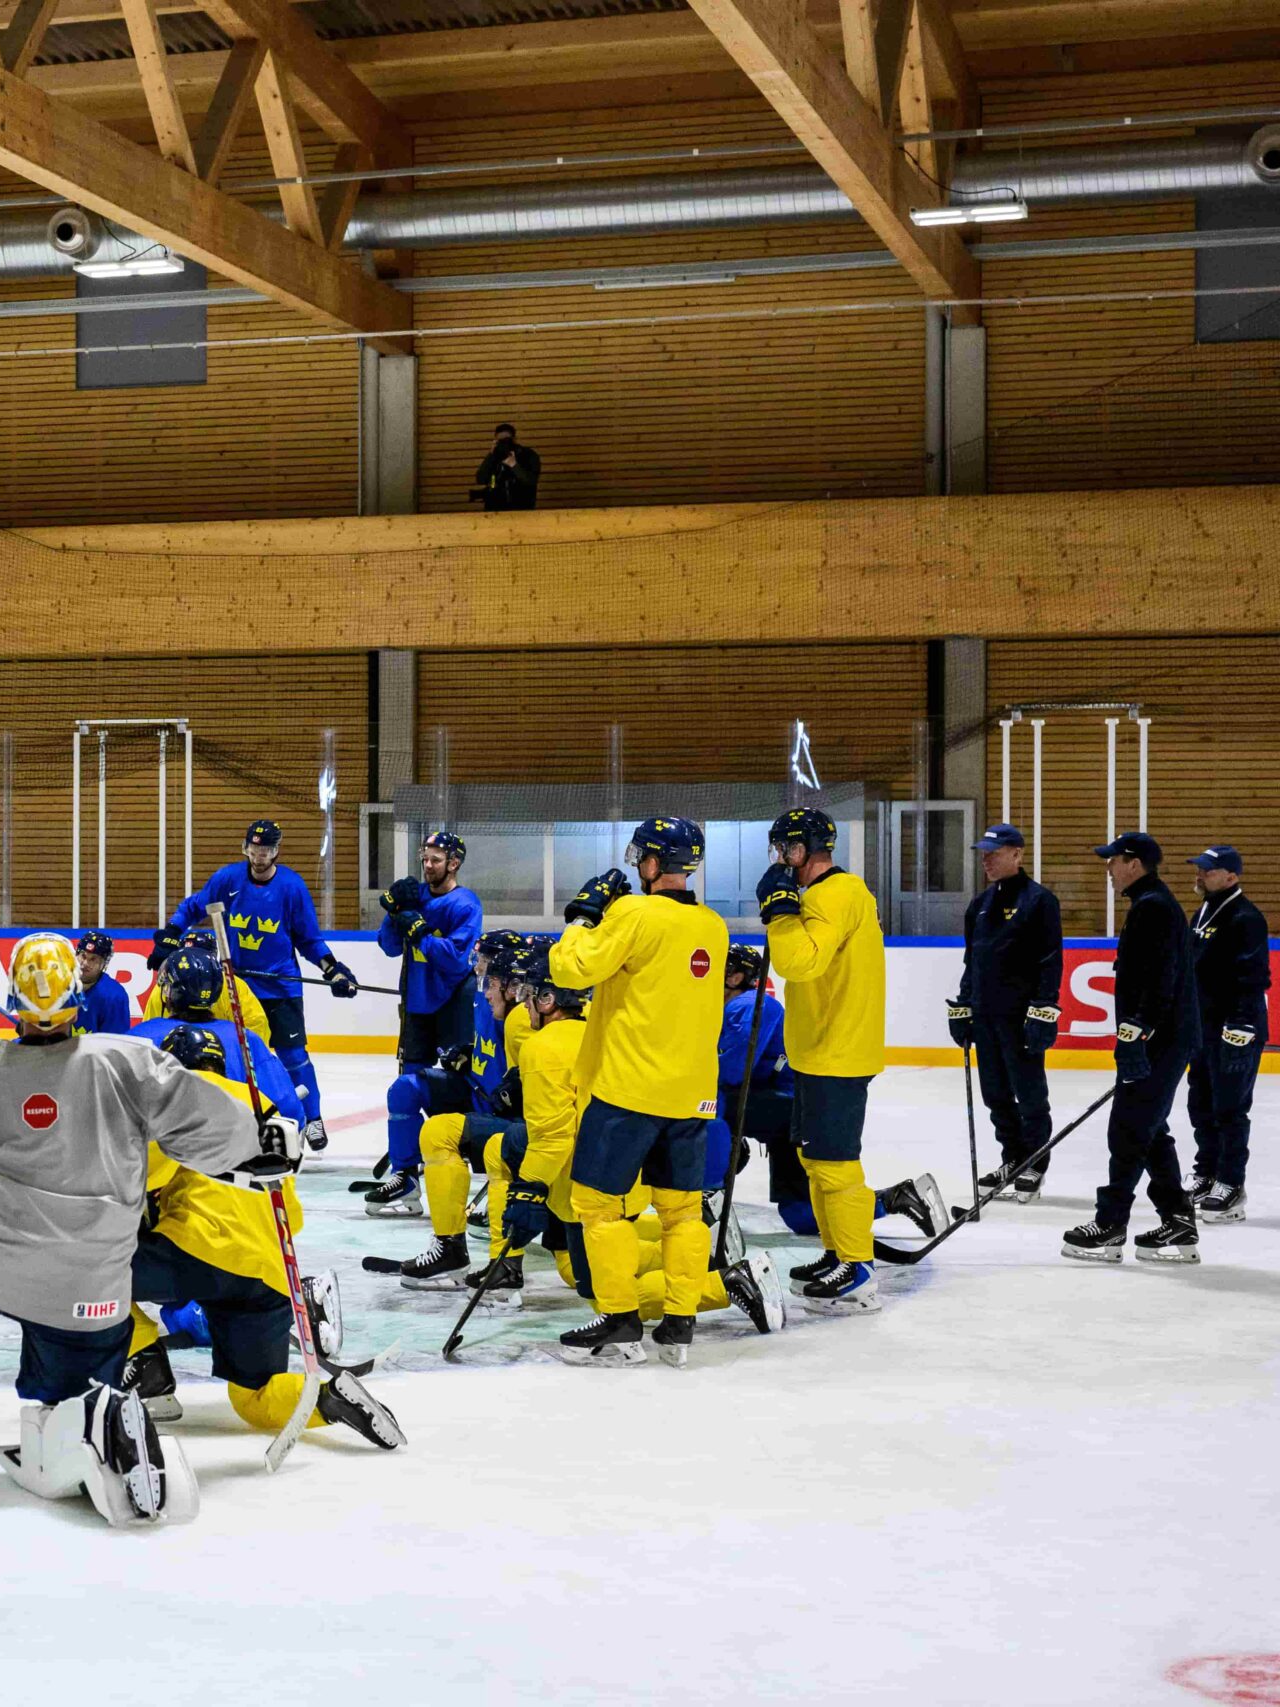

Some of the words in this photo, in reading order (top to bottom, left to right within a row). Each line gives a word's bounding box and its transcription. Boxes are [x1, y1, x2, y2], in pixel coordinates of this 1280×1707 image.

[691, 845, 701, 855] 72
[200, 990, 211, 999] 95
[26, 1107, 54, 1115] RESPECT
[87, 1302, 117, 1317] IIHF
